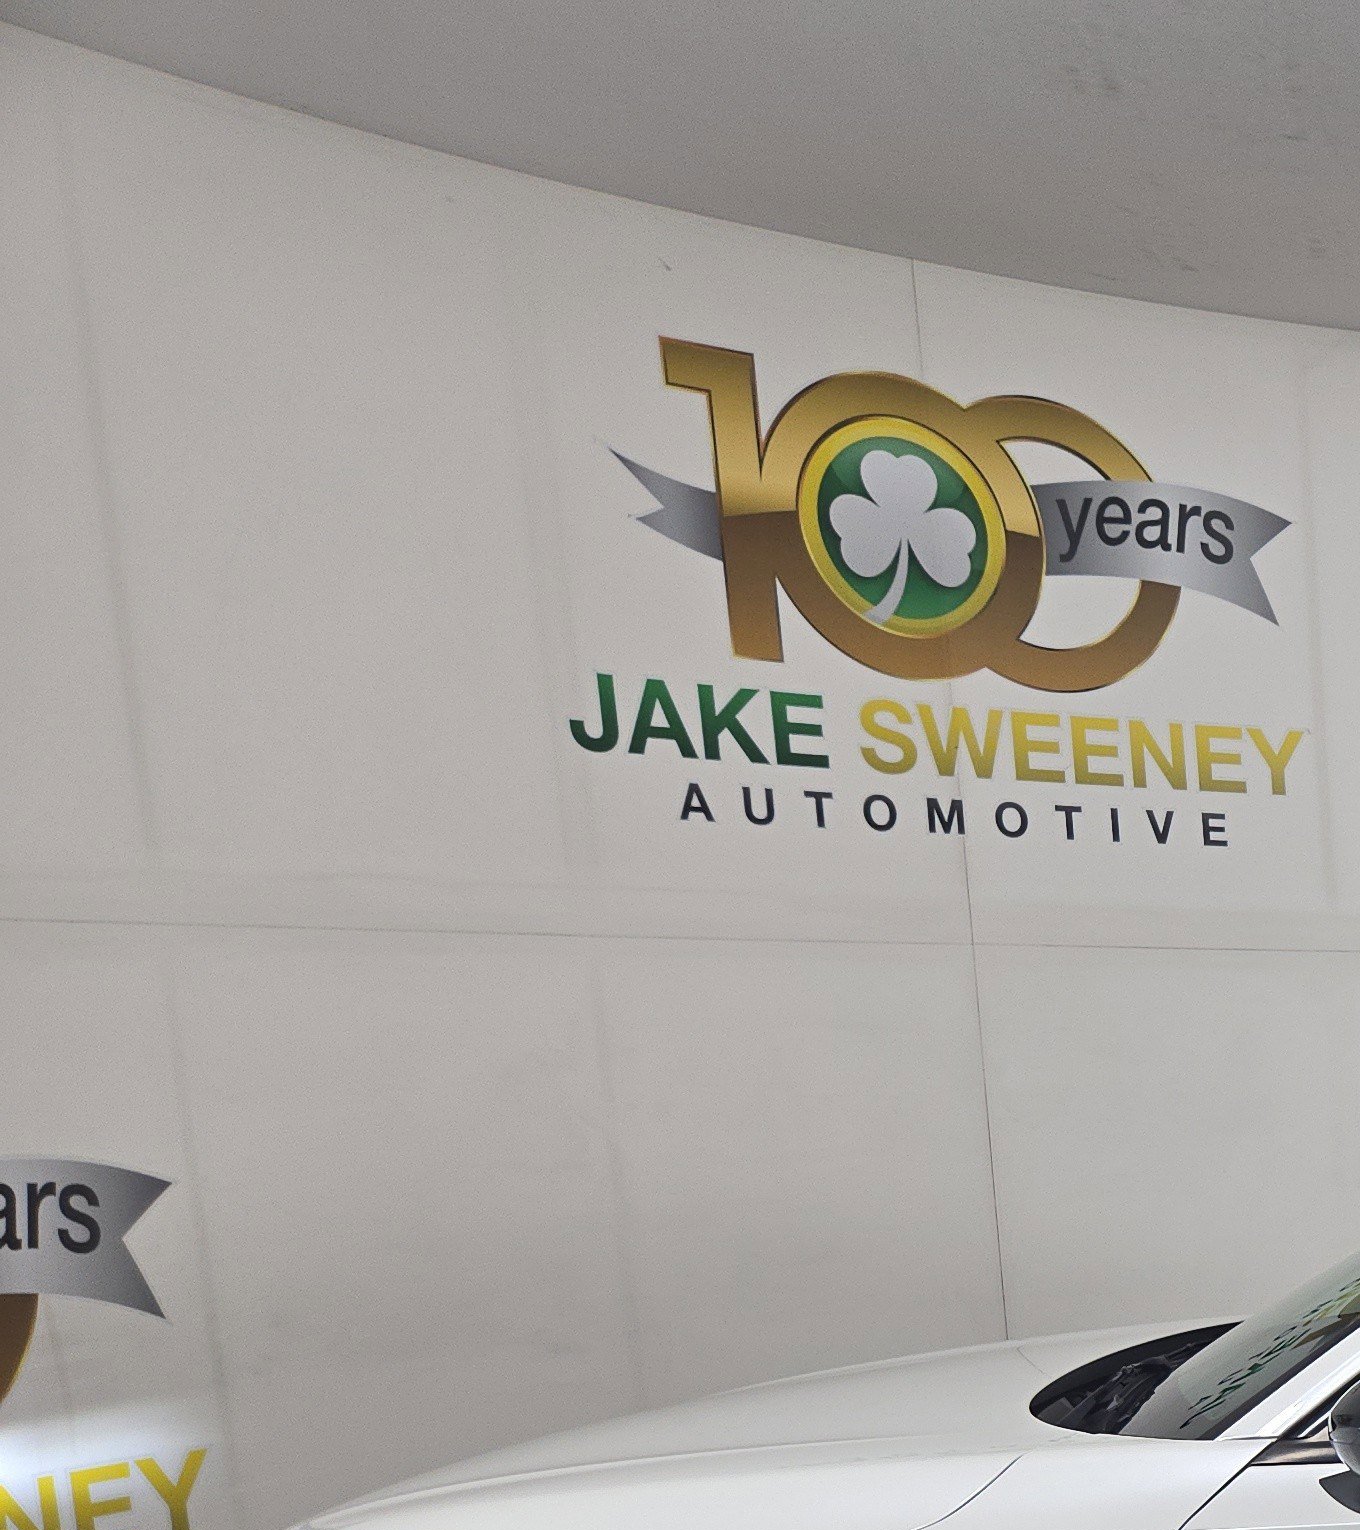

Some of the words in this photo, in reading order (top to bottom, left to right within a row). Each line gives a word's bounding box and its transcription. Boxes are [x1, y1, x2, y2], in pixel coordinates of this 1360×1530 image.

[1056, 489, 1236, 564] years
[569, 673, 830, 769] JAKE
[859, 699, 1304, 796] SWEENEY
[680, 782, 1229, 847] AUTOMOTIVE
